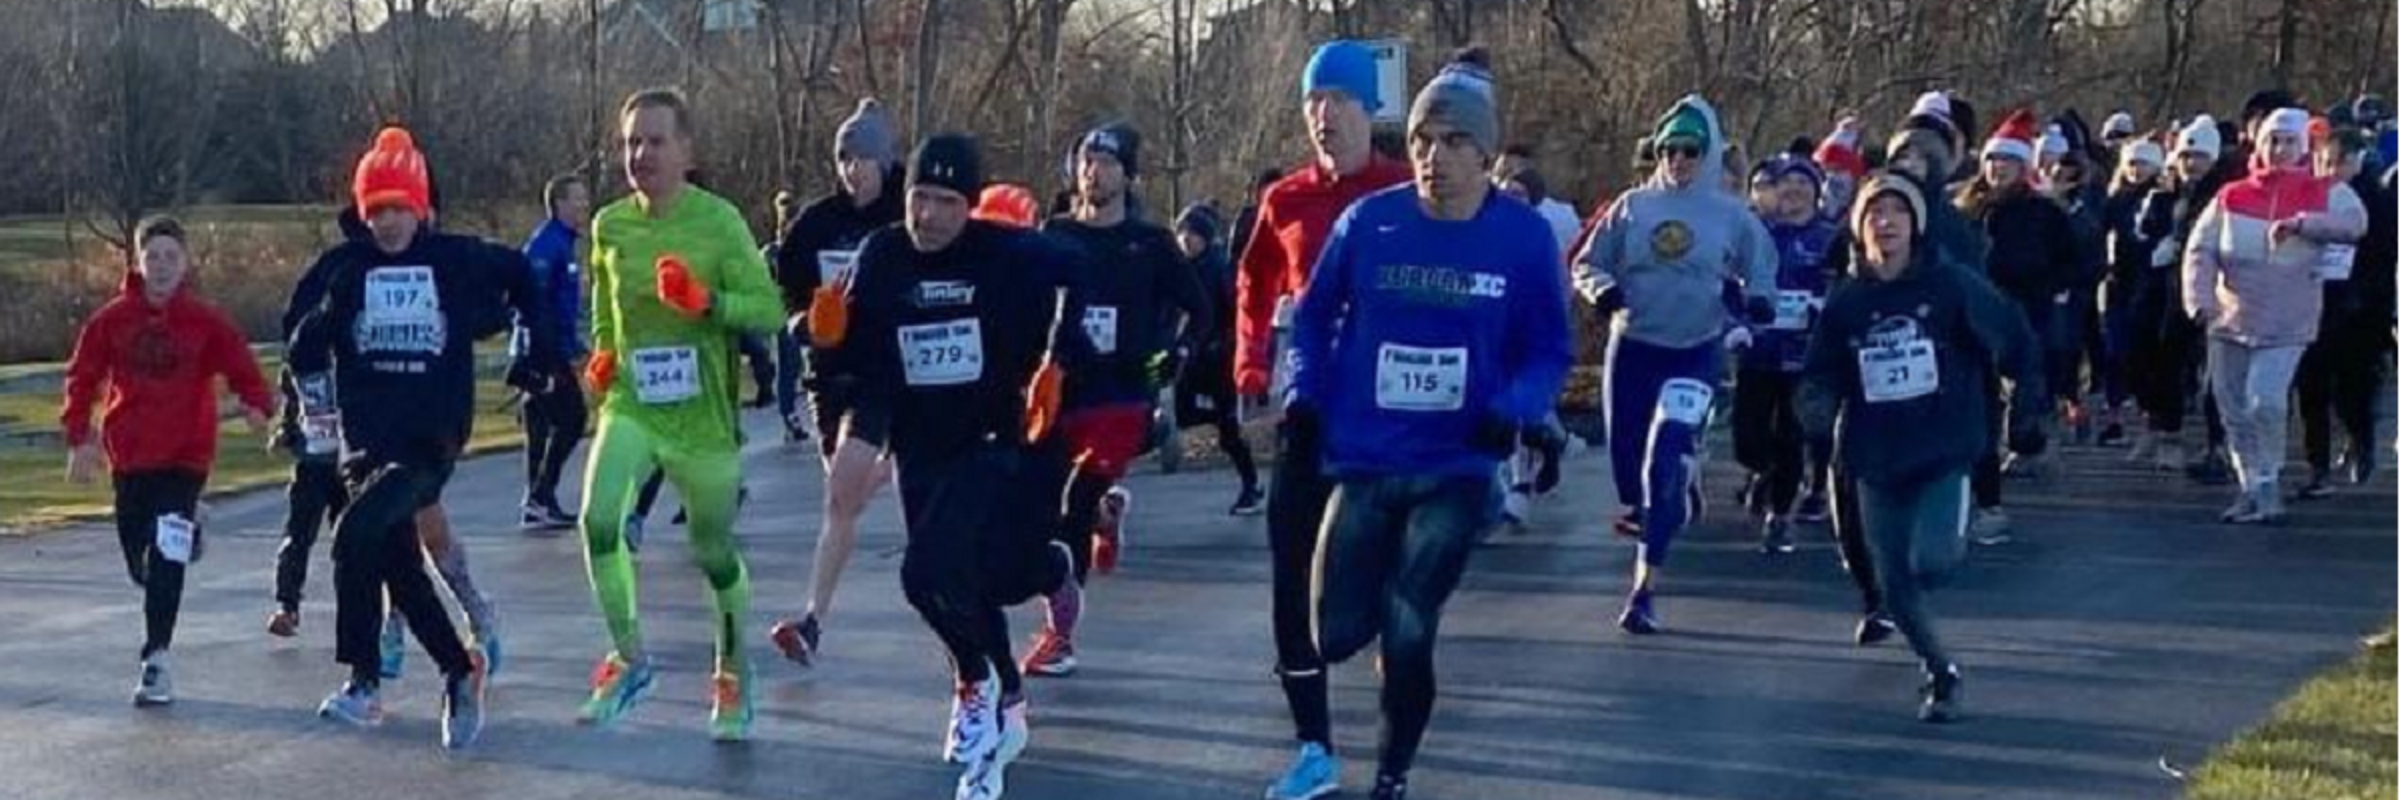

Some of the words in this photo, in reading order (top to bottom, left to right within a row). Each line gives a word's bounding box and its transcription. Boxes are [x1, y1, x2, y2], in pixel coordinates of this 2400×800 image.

[385, 288, 419, 308] 197
[919, 345, 961, 366] 279
[1401, 371, 1439, 393] 115
[1887, 365, 1909, 385] 21
